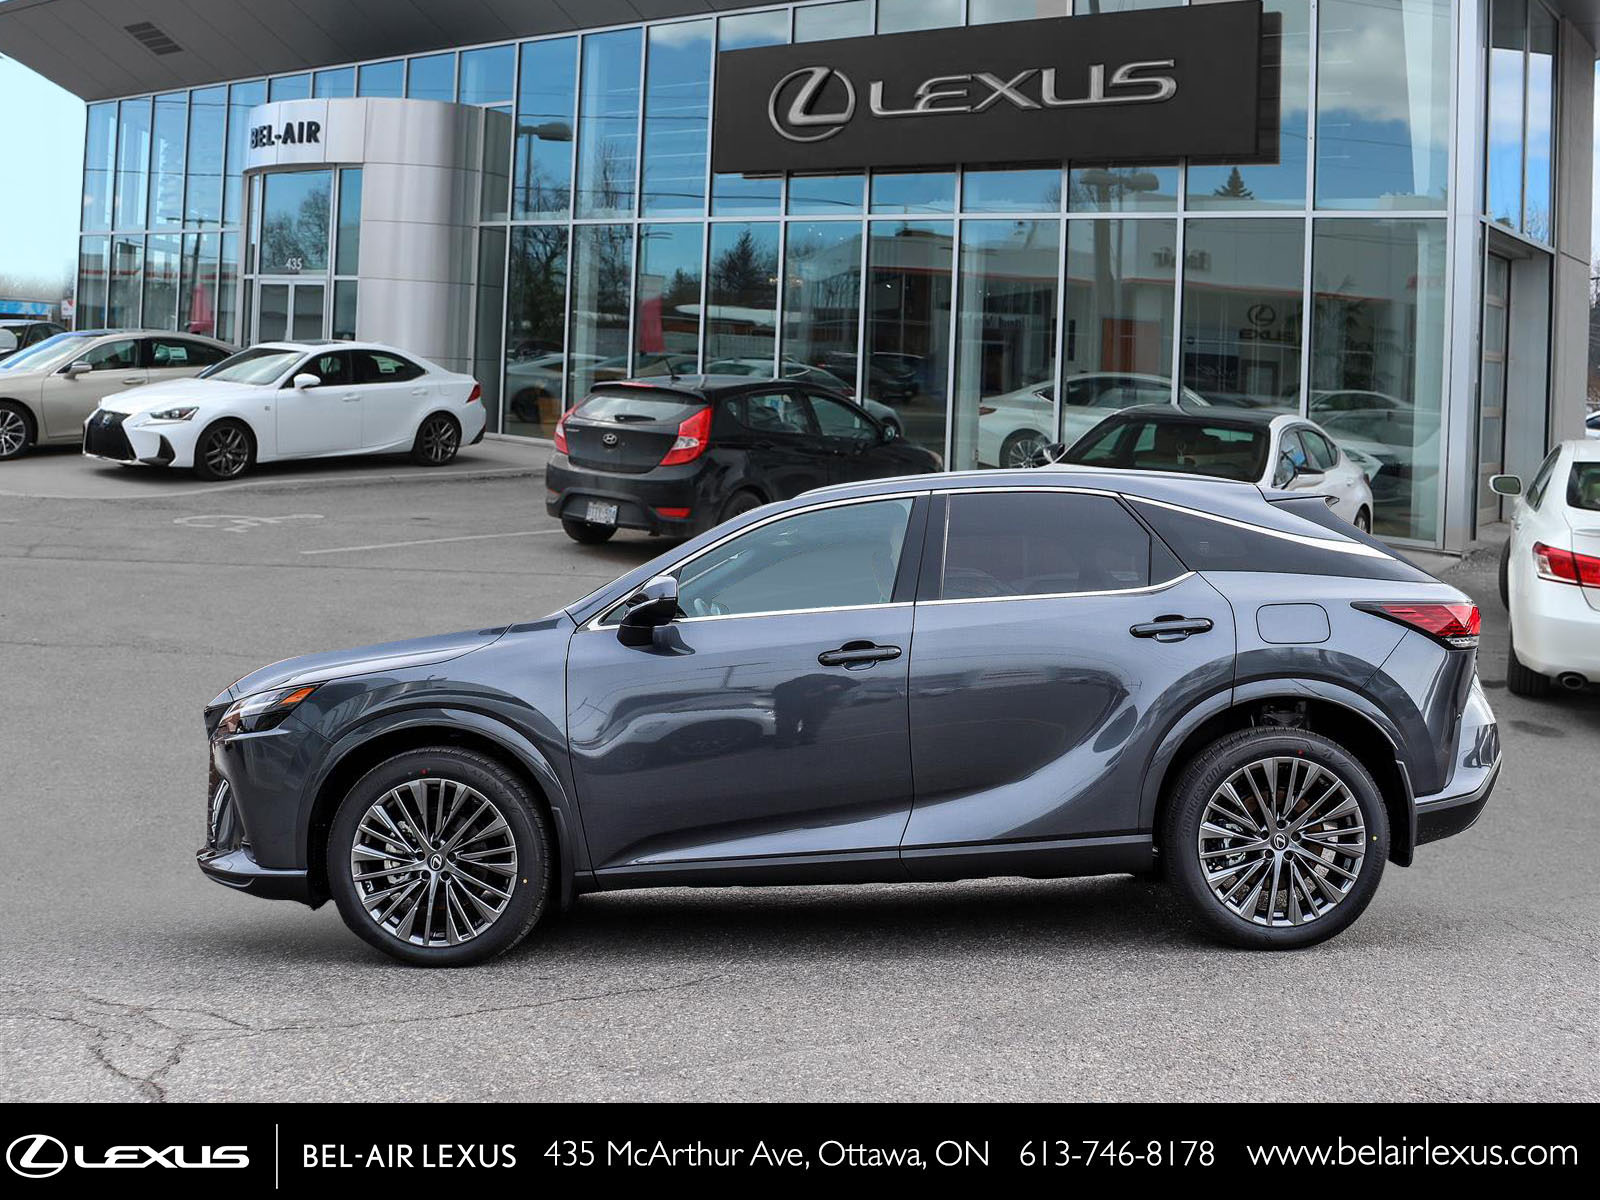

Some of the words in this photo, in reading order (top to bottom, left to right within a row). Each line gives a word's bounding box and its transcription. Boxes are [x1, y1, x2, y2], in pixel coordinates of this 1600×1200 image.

[867, 58, 1178, 118] LEXUS
[250, 120, 321, 149] BEL-AIR
[285, 257, 303, 270] 435
